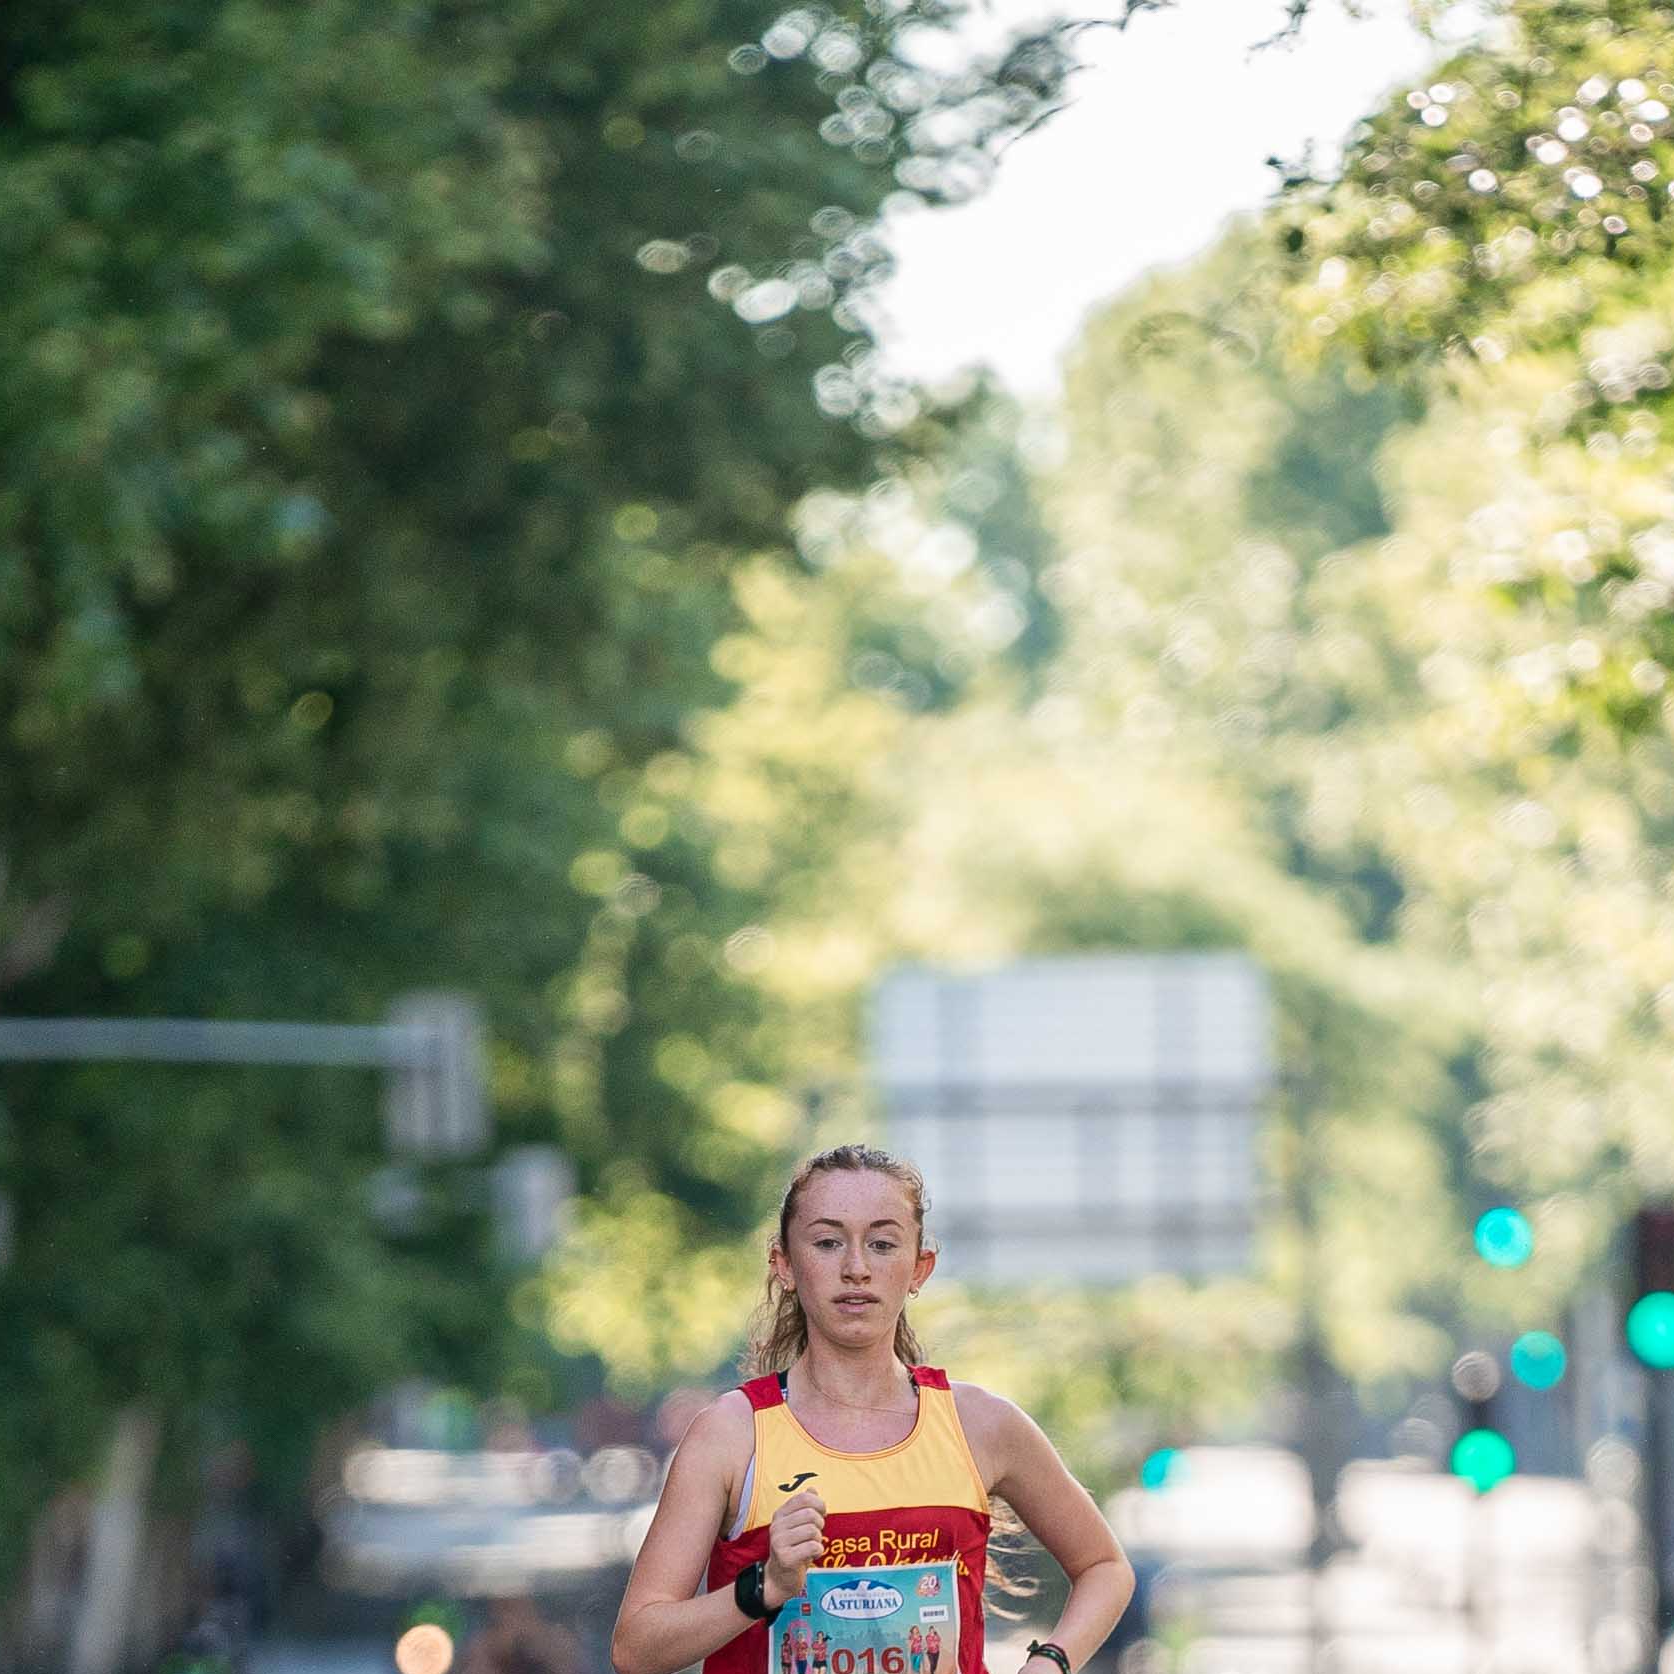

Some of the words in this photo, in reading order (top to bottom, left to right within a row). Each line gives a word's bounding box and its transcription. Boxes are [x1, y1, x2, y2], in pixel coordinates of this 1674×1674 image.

[879, 1528, 939, 1550] Rural
[920, 1576, 937, 1589] 20
[827, 1595, 898, 1610] ASTURIANA
